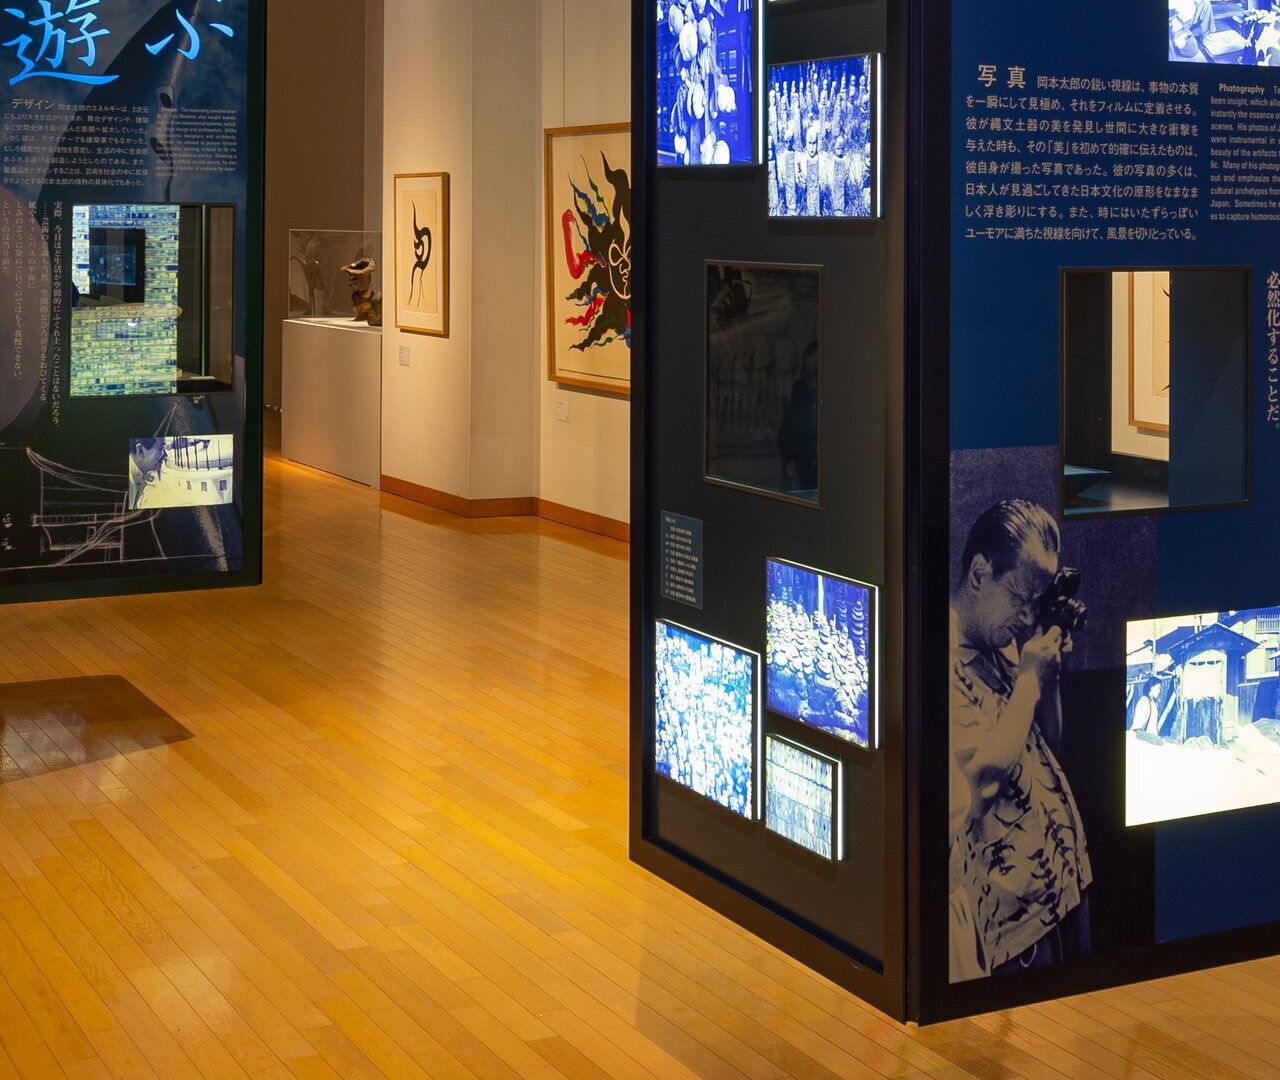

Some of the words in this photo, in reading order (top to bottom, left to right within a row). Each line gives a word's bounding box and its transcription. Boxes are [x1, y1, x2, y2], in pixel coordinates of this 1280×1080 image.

[977, 64, 1026, 89] 写真
[1037, 76, 1199, 96] 岡本太郎の鋭い視線は、事物の本質
[1219, 83, 1265, 95] Photography
[11, 98, 55, 110] デザイン
[1250, 98, 1268, 106] which
[1248, 123, 1268, 133] photos
[1270, 124, 1276, 132] of
[1267, 270, 1280, 429] 必然化することだ。
